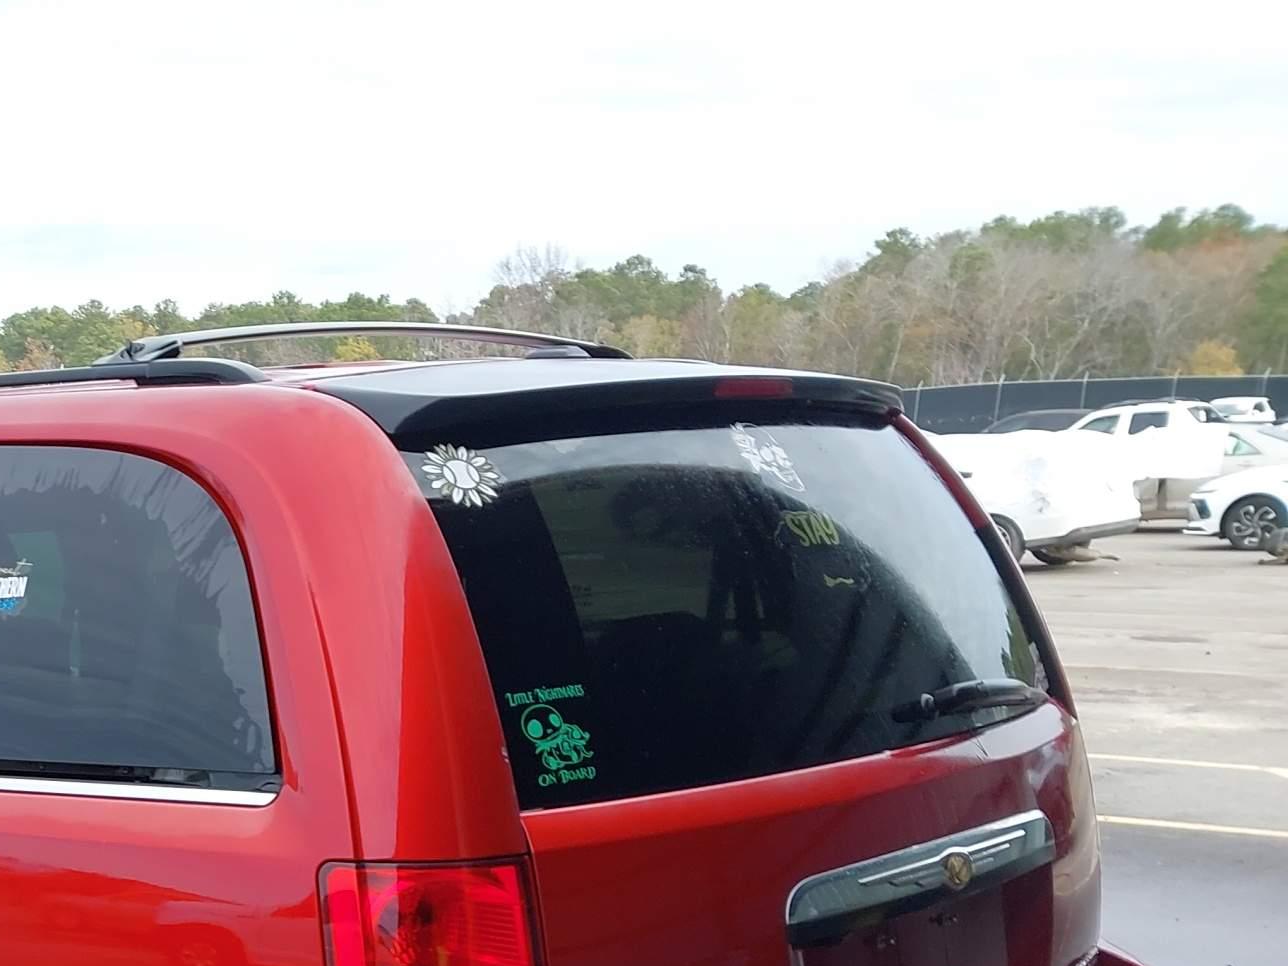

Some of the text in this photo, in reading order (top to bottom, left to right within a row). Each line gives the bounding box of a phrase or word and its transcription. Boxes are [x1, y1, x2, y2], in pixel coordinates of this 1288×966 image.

[783, 511, 840, 547] STAY
[538, 766, 597, 787] ON BOARD
